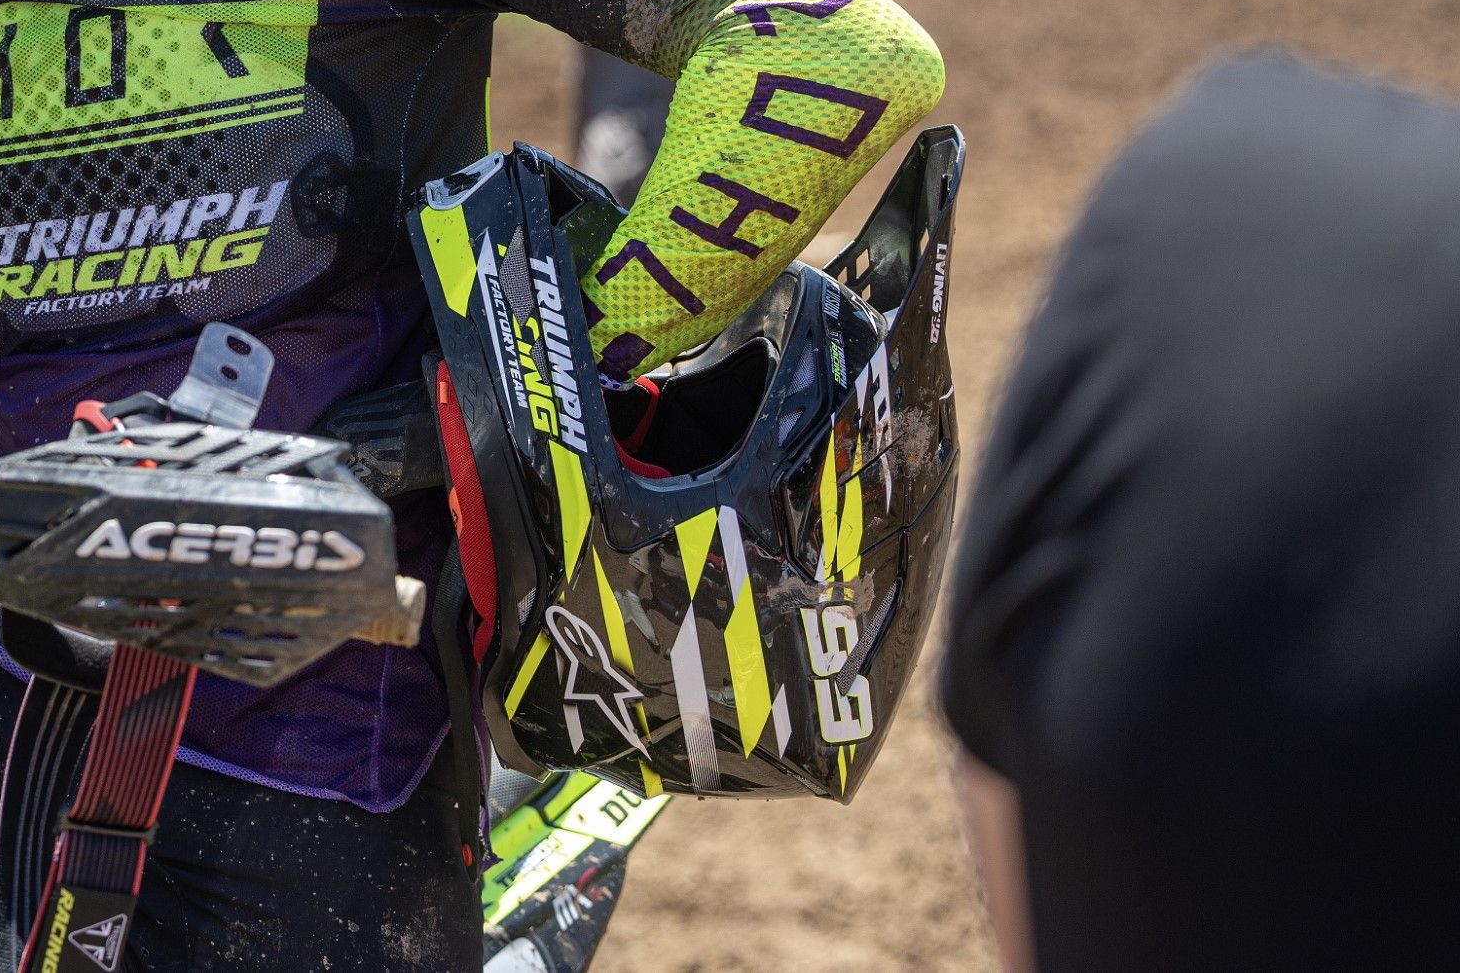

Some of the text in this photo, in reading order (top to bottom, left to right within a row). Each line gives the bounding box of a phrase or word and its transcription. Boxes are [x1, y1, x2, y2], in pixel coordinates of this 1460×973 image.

[23, 277, 212, 315] FACTORY TEAM
[486, 278, 529, 409] FACTORY TEAM
[529, 255, 588, 454] TRIUMPH
